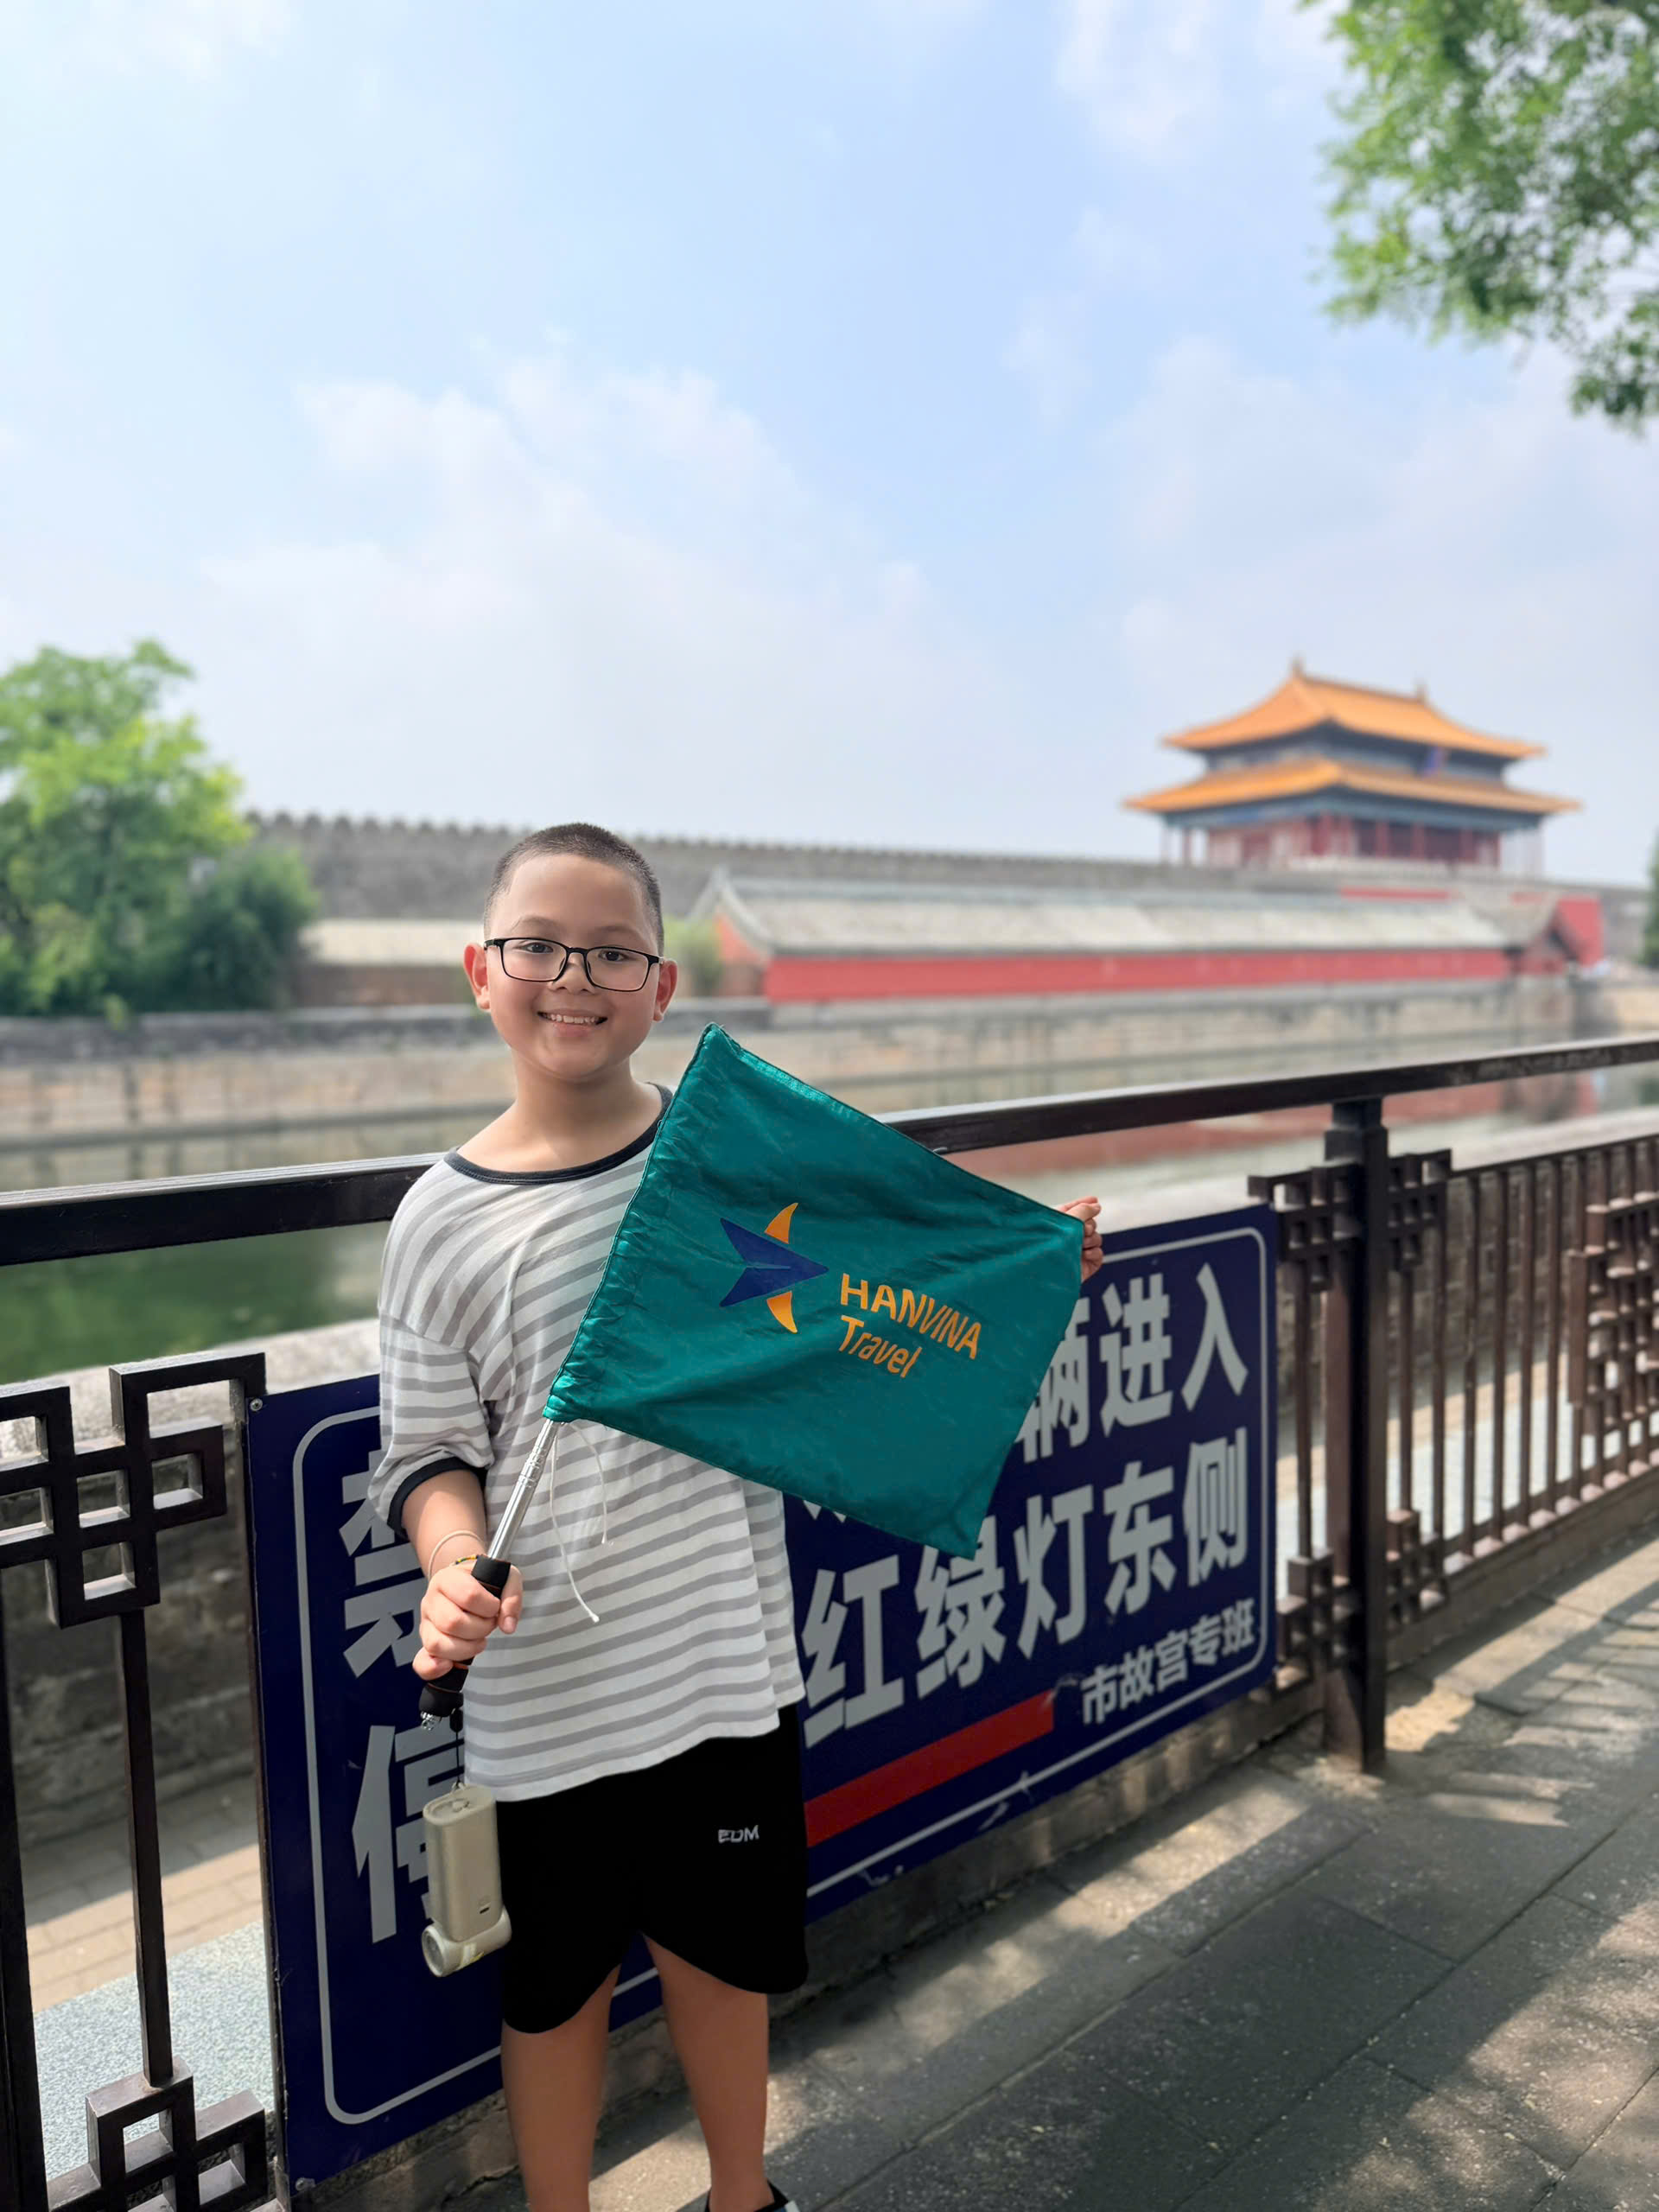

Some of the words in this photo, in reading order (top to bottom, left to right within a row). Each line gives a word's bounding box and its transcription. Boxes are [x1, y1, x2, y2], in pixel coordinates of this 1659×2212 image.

[839, 1315, 923, 1378] Travel
[840, 1274, 982, 1359] HANVINA
[802, 1427, 1247, 1748] 红绿灯东侧
[1081, 1599, 1255, 1725] 市故宫专班
